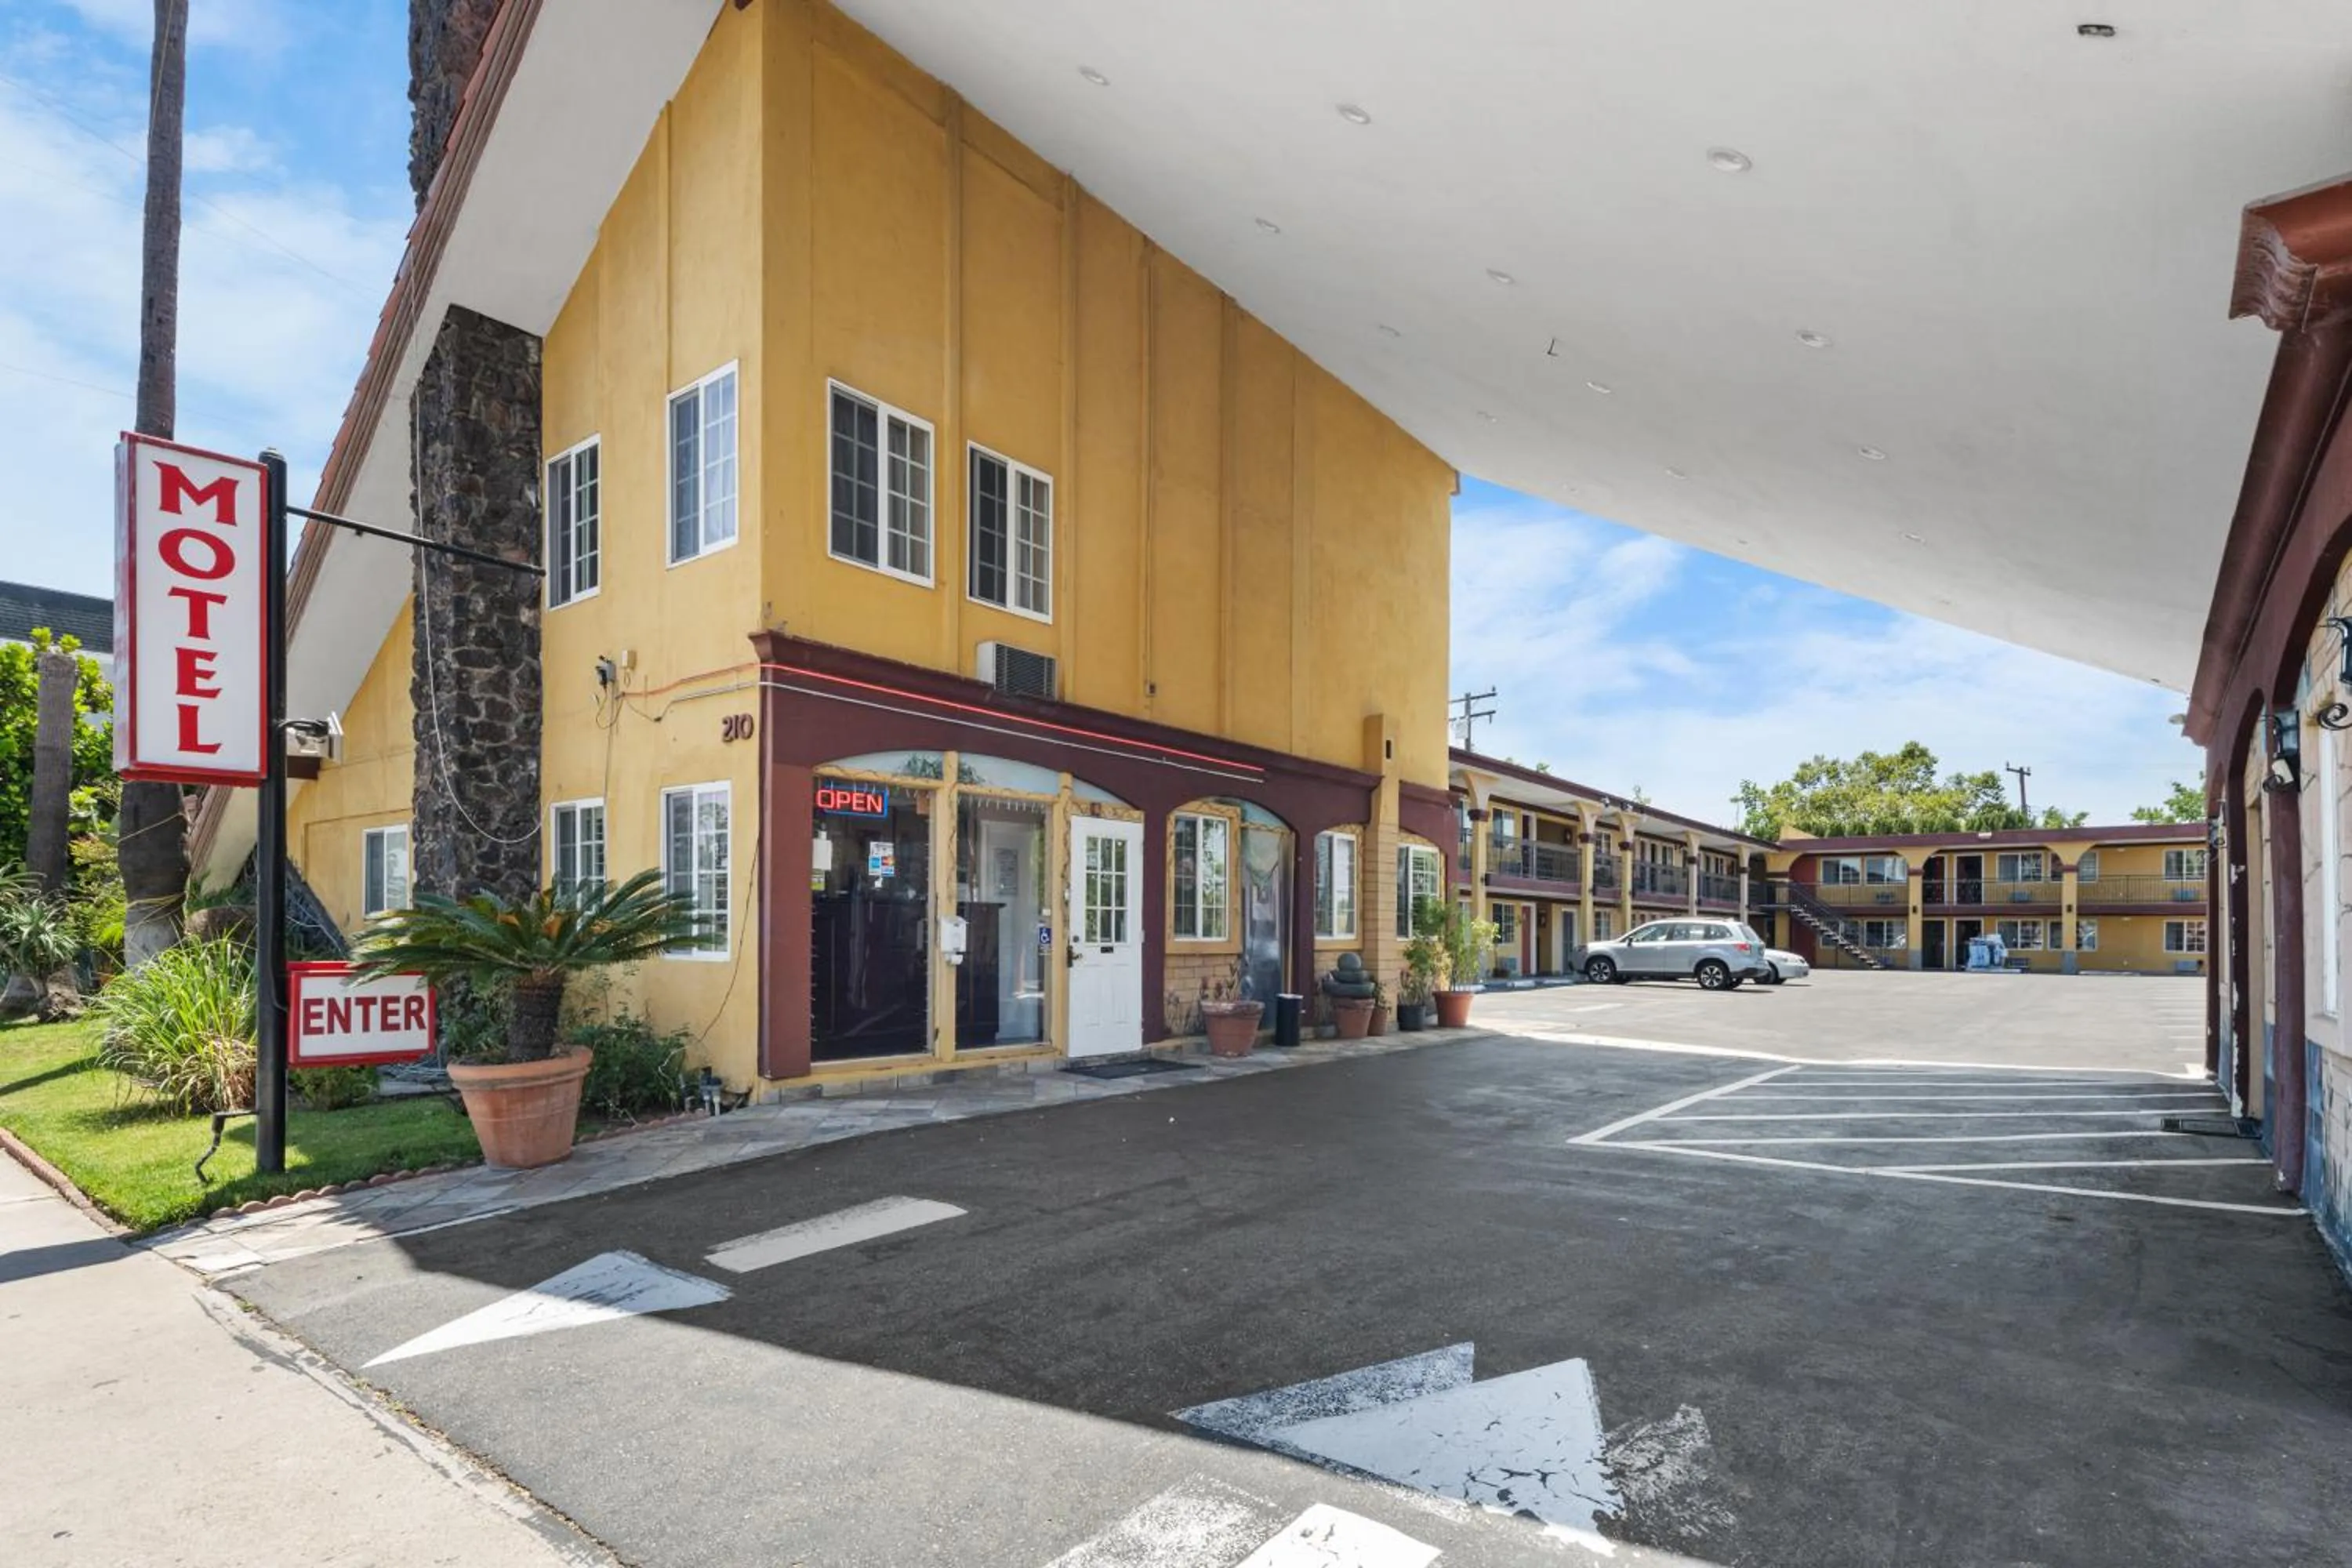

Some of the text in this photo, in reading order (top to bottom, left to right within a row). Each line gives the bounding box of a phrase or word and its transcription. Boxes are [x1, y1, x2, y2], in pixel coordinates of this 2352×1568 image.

[153, 460, 240, 754] MOTEL
[722, 713, 754, 743] 210
[816, 789, 883, 813] OPEN
[303, 996, 426, 1035] ENTER
